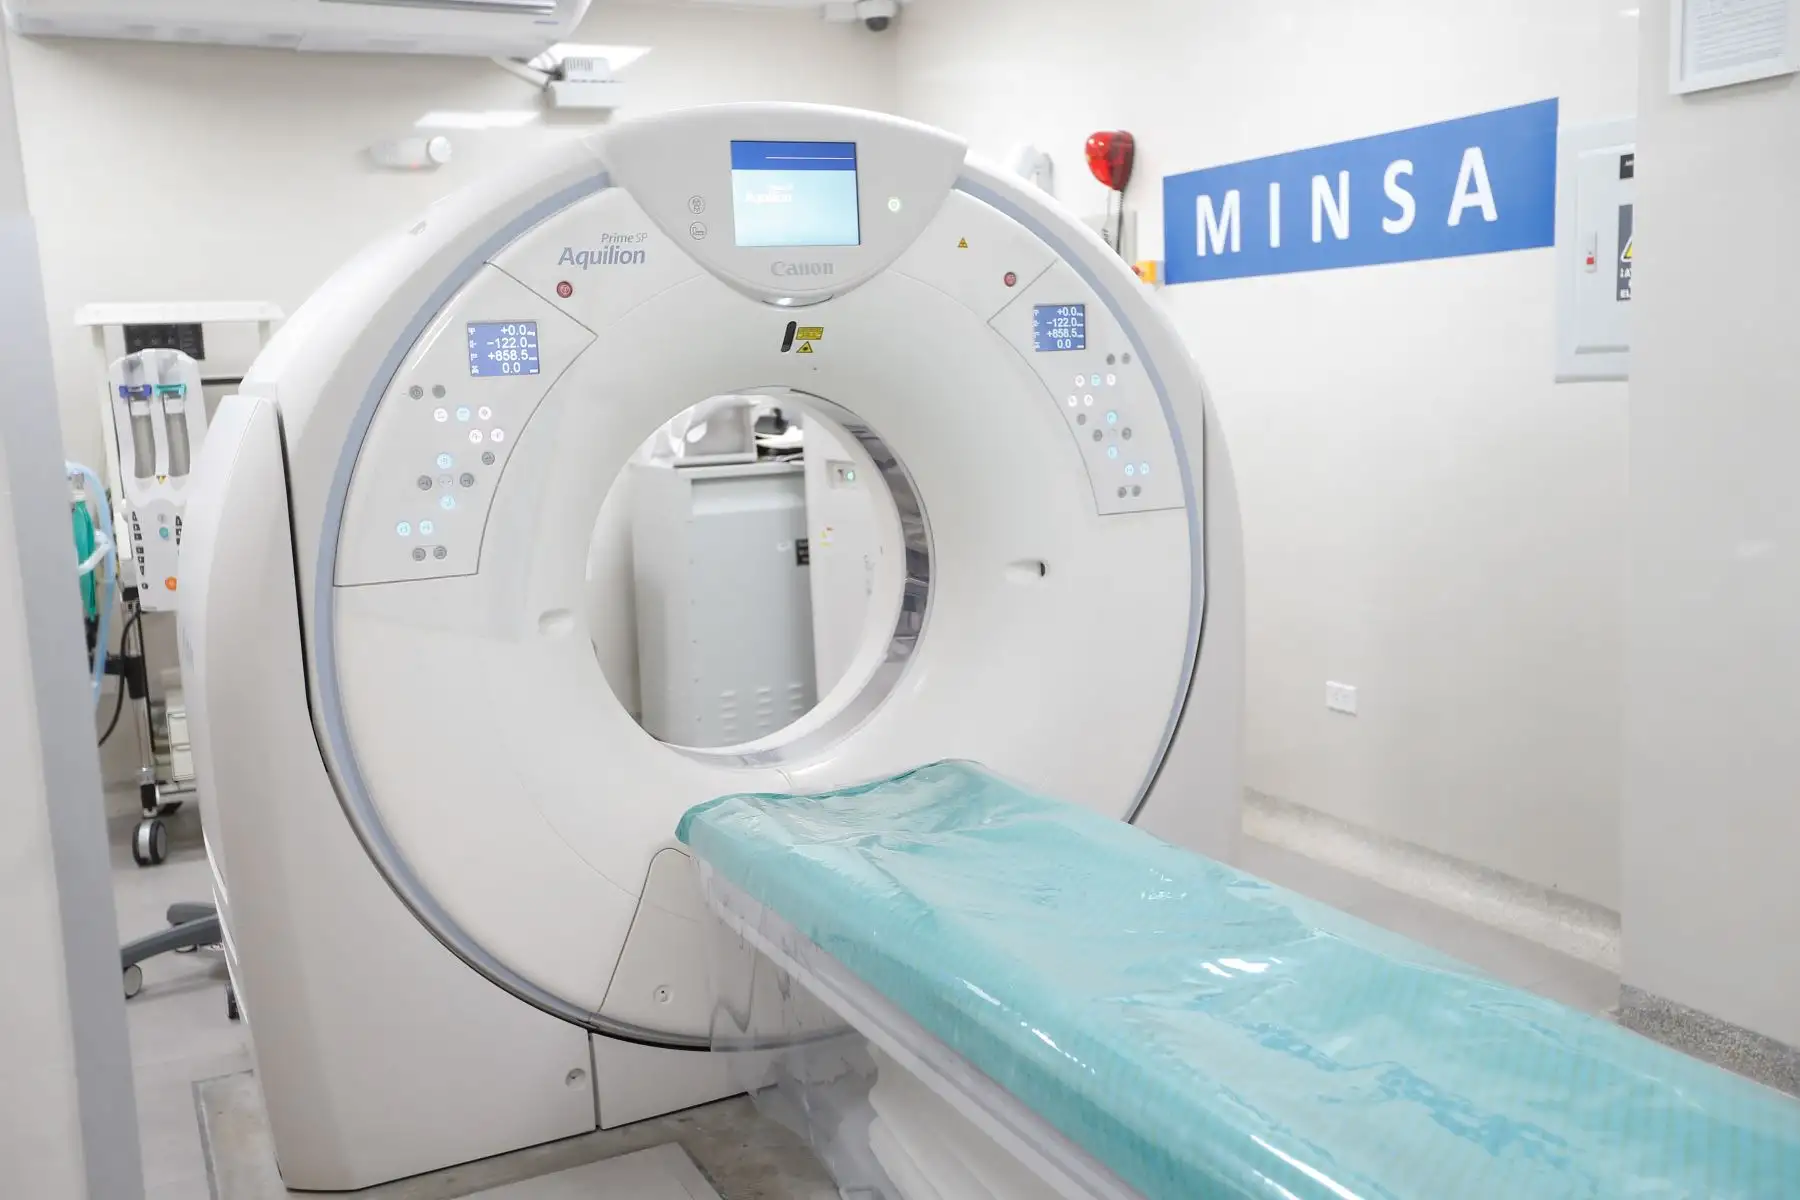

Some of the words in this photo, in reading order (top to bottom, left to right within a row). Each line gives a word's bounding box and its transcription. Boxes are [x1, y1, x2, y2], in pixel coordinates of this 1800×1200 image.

[1196, 146, 1498, 257] MINSA
[601, 232, 634, 243] Prime
[635, 232, 648, 243] SP
[558, 245, 646, 270] Aquilion
[770, 261, 834, 276] Canon
[1056, 306, 1077, 317] +0.0
[1045, 317, 1077, 328] -122.0
[500, 324, 527, 336] +0.0
[1047, 328, 1077, 338] +858.5
[486, 337, 528, 349] -122.0
[1057, 338, 1071, 349] 0.0
[487, 349, 529, 361] +858.5
[502, 362, 521, 374] 0.0
